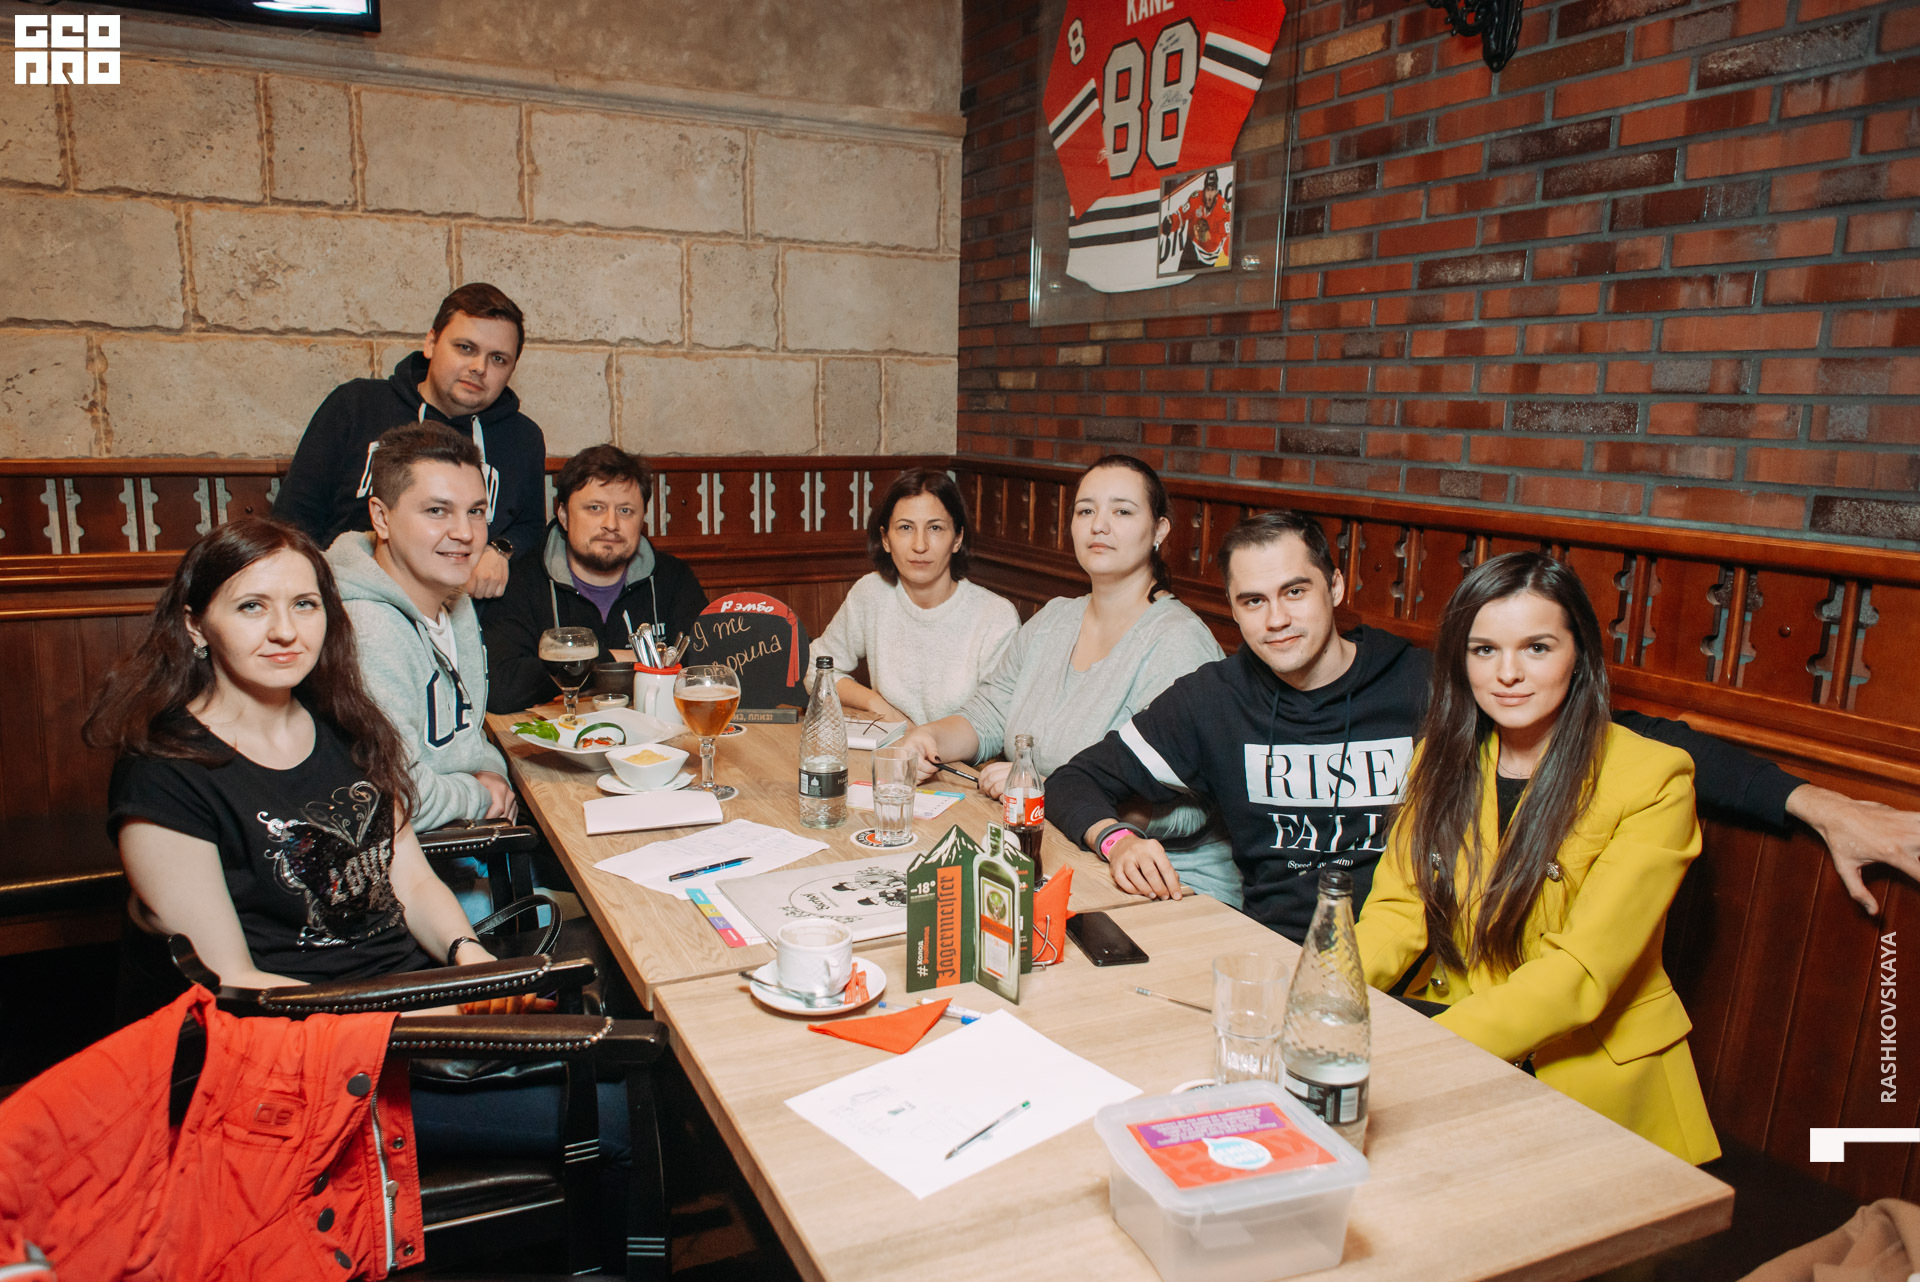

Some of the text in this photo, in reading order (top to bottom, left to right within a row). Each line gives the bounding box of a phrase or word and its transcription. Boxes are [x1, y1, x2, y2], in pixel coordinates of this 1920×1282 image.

[1102, 17, 1200, 179] 88
[720, 600, 775, 613] Рэмбо
[693, 621, 709, 652] Я
[1259, 749, 1399, 799] RISE
[1267, 812, 1387, 852] FALL
